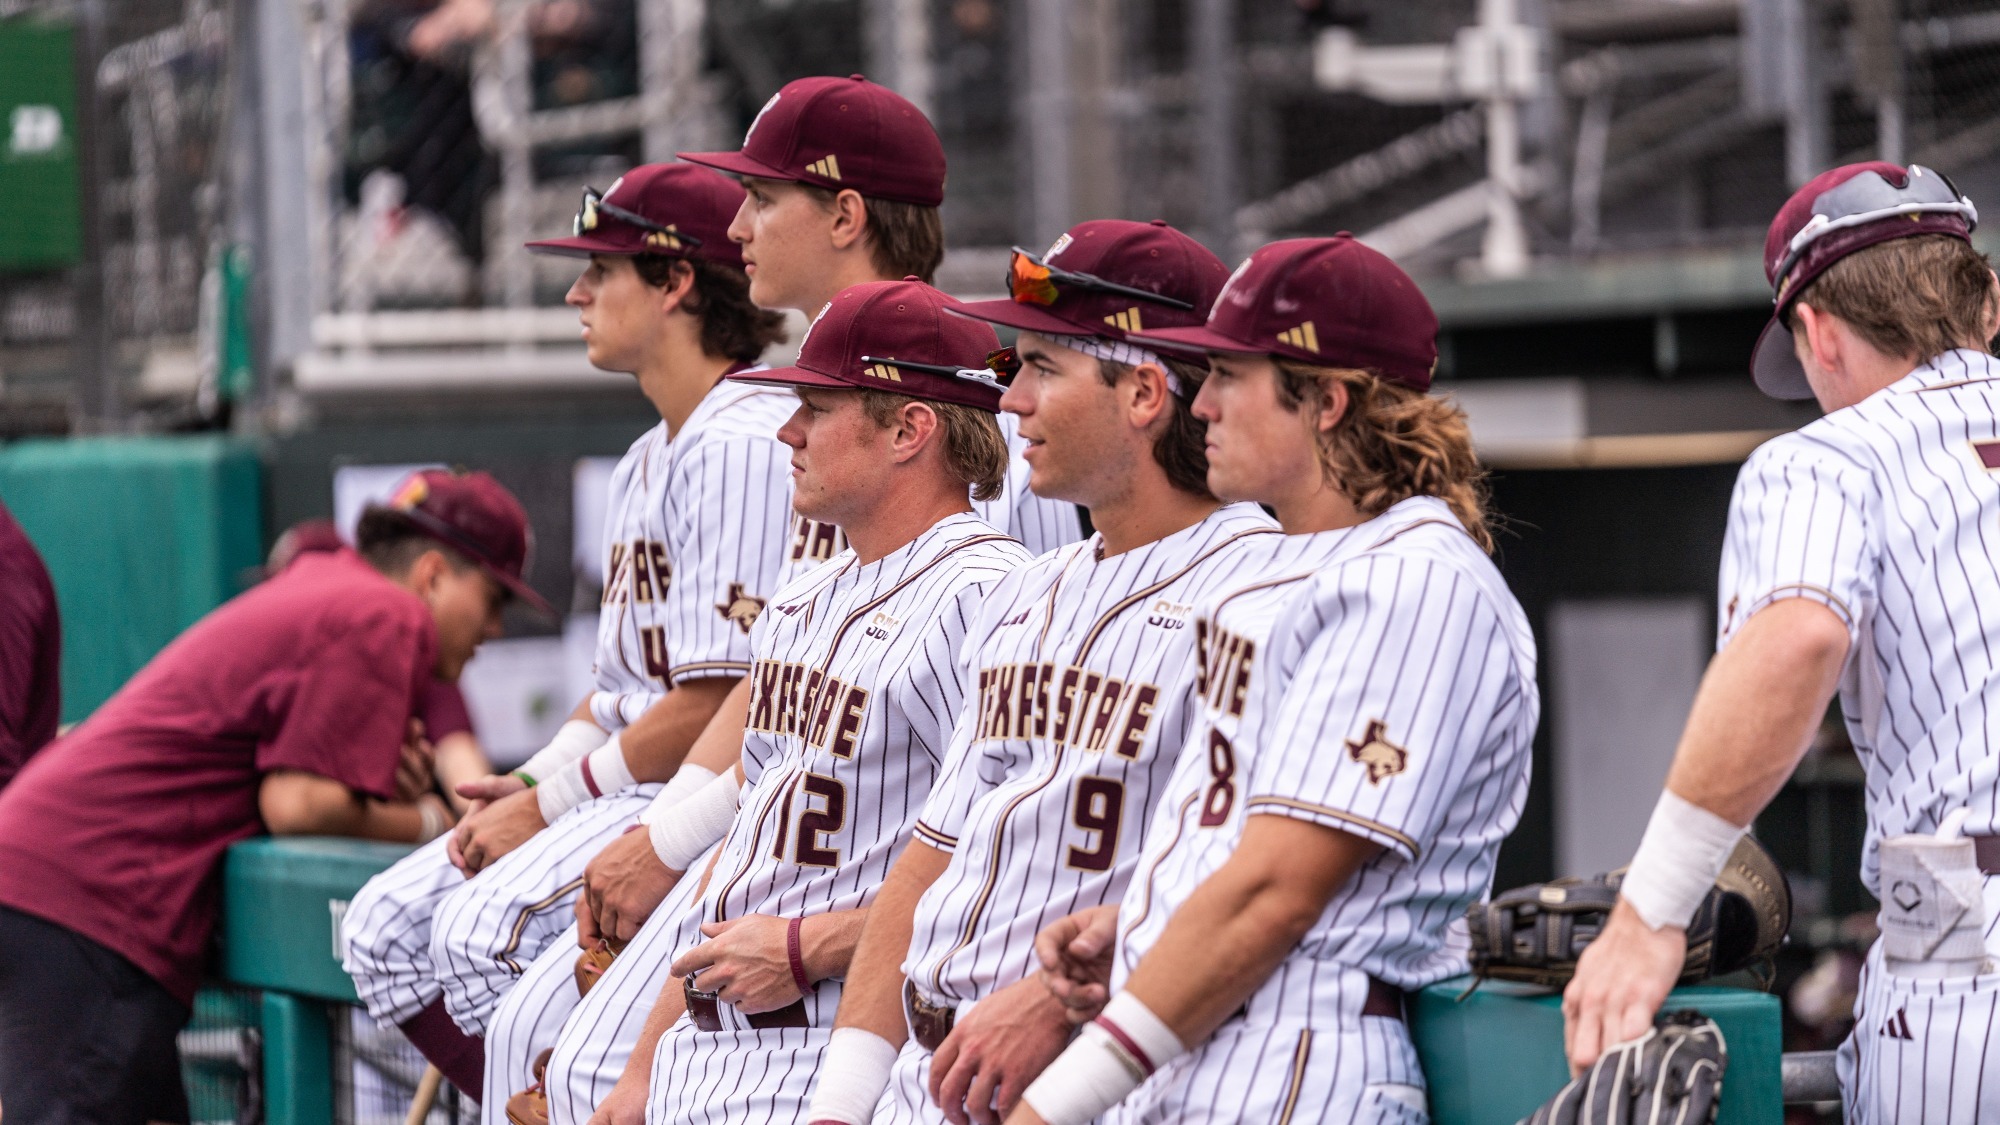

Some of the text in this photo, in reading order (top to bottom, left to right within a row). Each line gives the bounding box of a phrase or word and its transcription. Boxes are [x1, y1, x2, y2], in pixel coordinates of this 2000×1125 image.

[771, 771, 847, 869] 12
[1065, 774, 1127, 874] 9
[1200, 726, 1236, 829] 8
